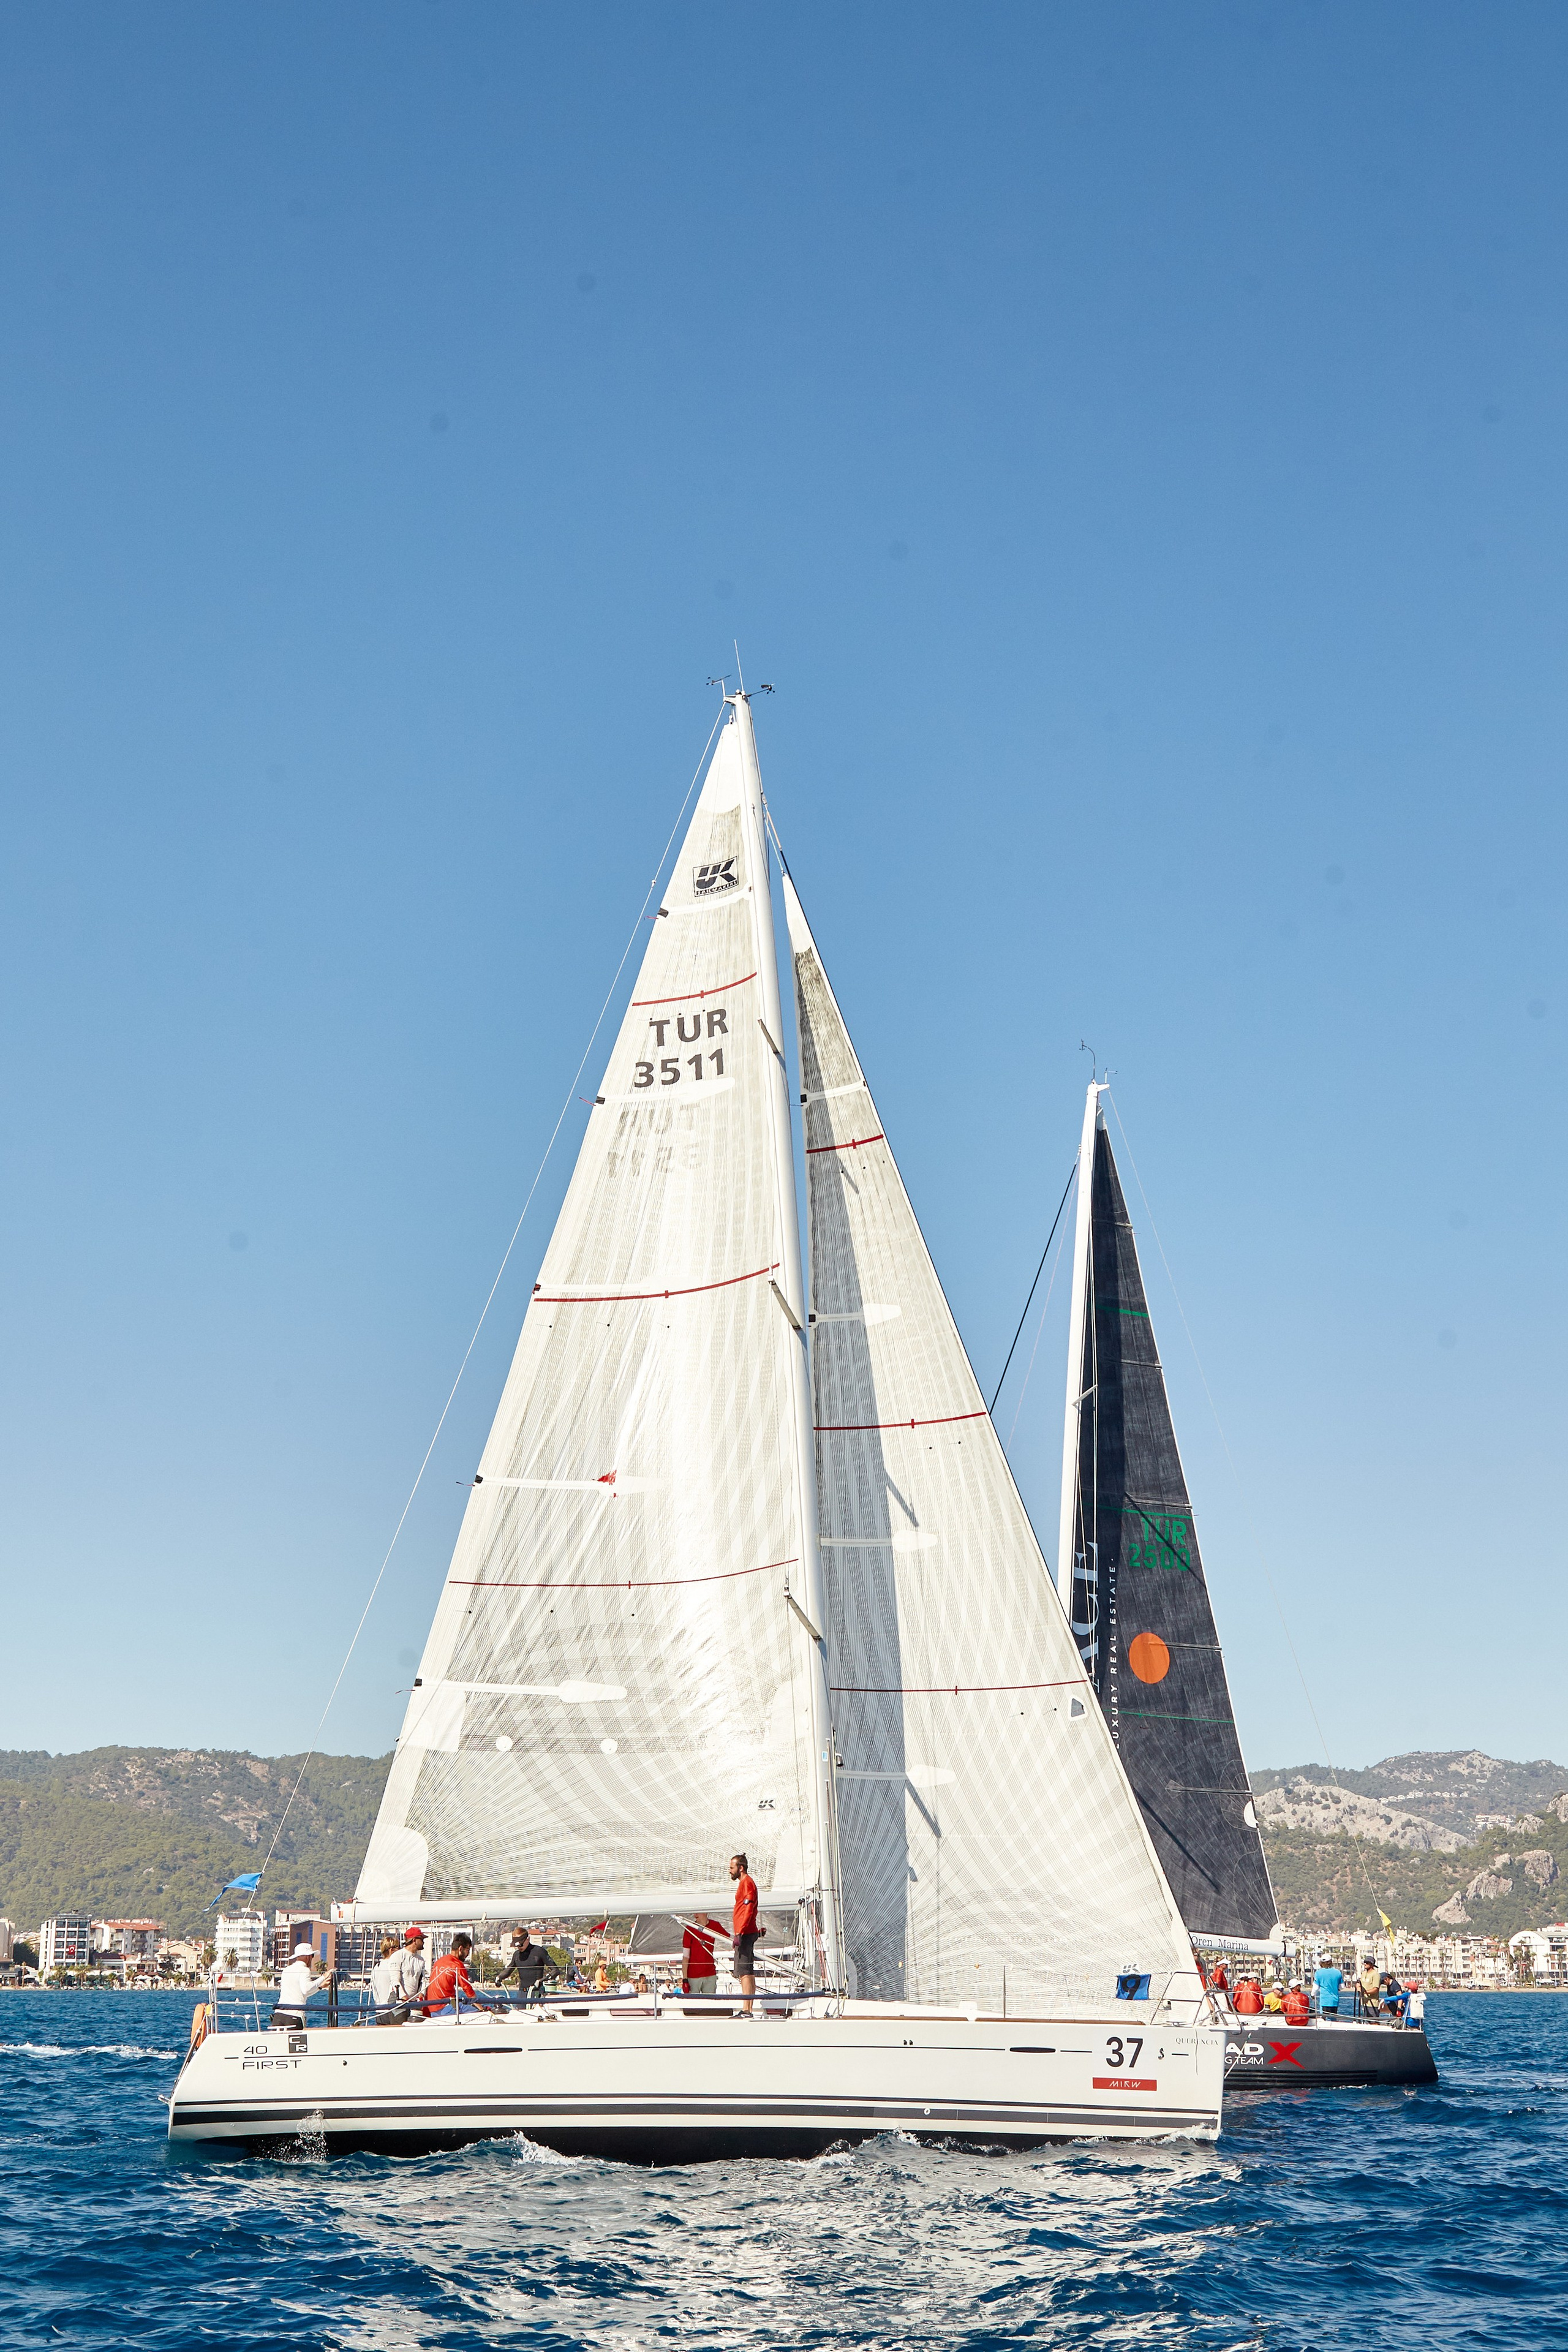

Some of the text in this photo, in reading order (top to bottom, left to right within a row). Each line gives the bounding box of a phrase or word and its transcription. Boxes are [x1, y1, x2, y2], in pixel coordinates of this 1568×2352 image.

[649, 1009, 729, 1047] TUR
[634, 1048, 724, 1088] 3511
[1141, 1517, 1186, 1545] TUR
[1128, 1543, 1190, 1571] 2500
[1218, 1939, 1249, 1951] Marina
[244, 2046, 267, 2054] 40
[1106, 2037, 1144, 2068] 37
[1235, 2056, 1264, 2065] TEAM
[243, 2060, 302, 2070] FIRST
